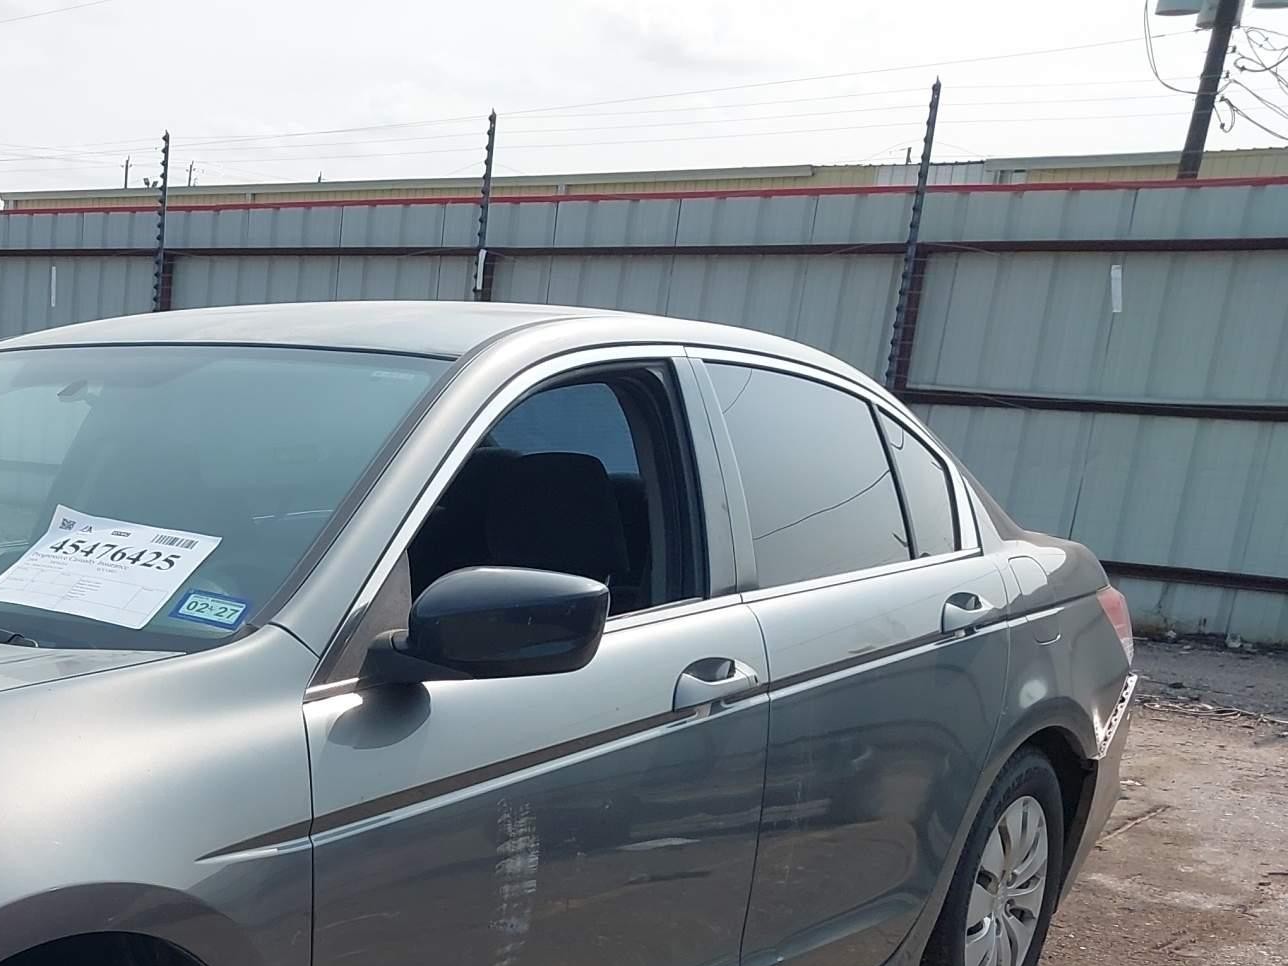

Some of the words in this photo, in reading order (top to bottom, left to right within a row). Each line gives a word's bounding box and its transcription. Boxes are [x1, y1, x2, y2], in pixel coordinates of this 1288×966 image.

[49, 537, 182, 571] 45476425
[186, 599, 210, 614] 02
[213, 606, 241, 620] 27
